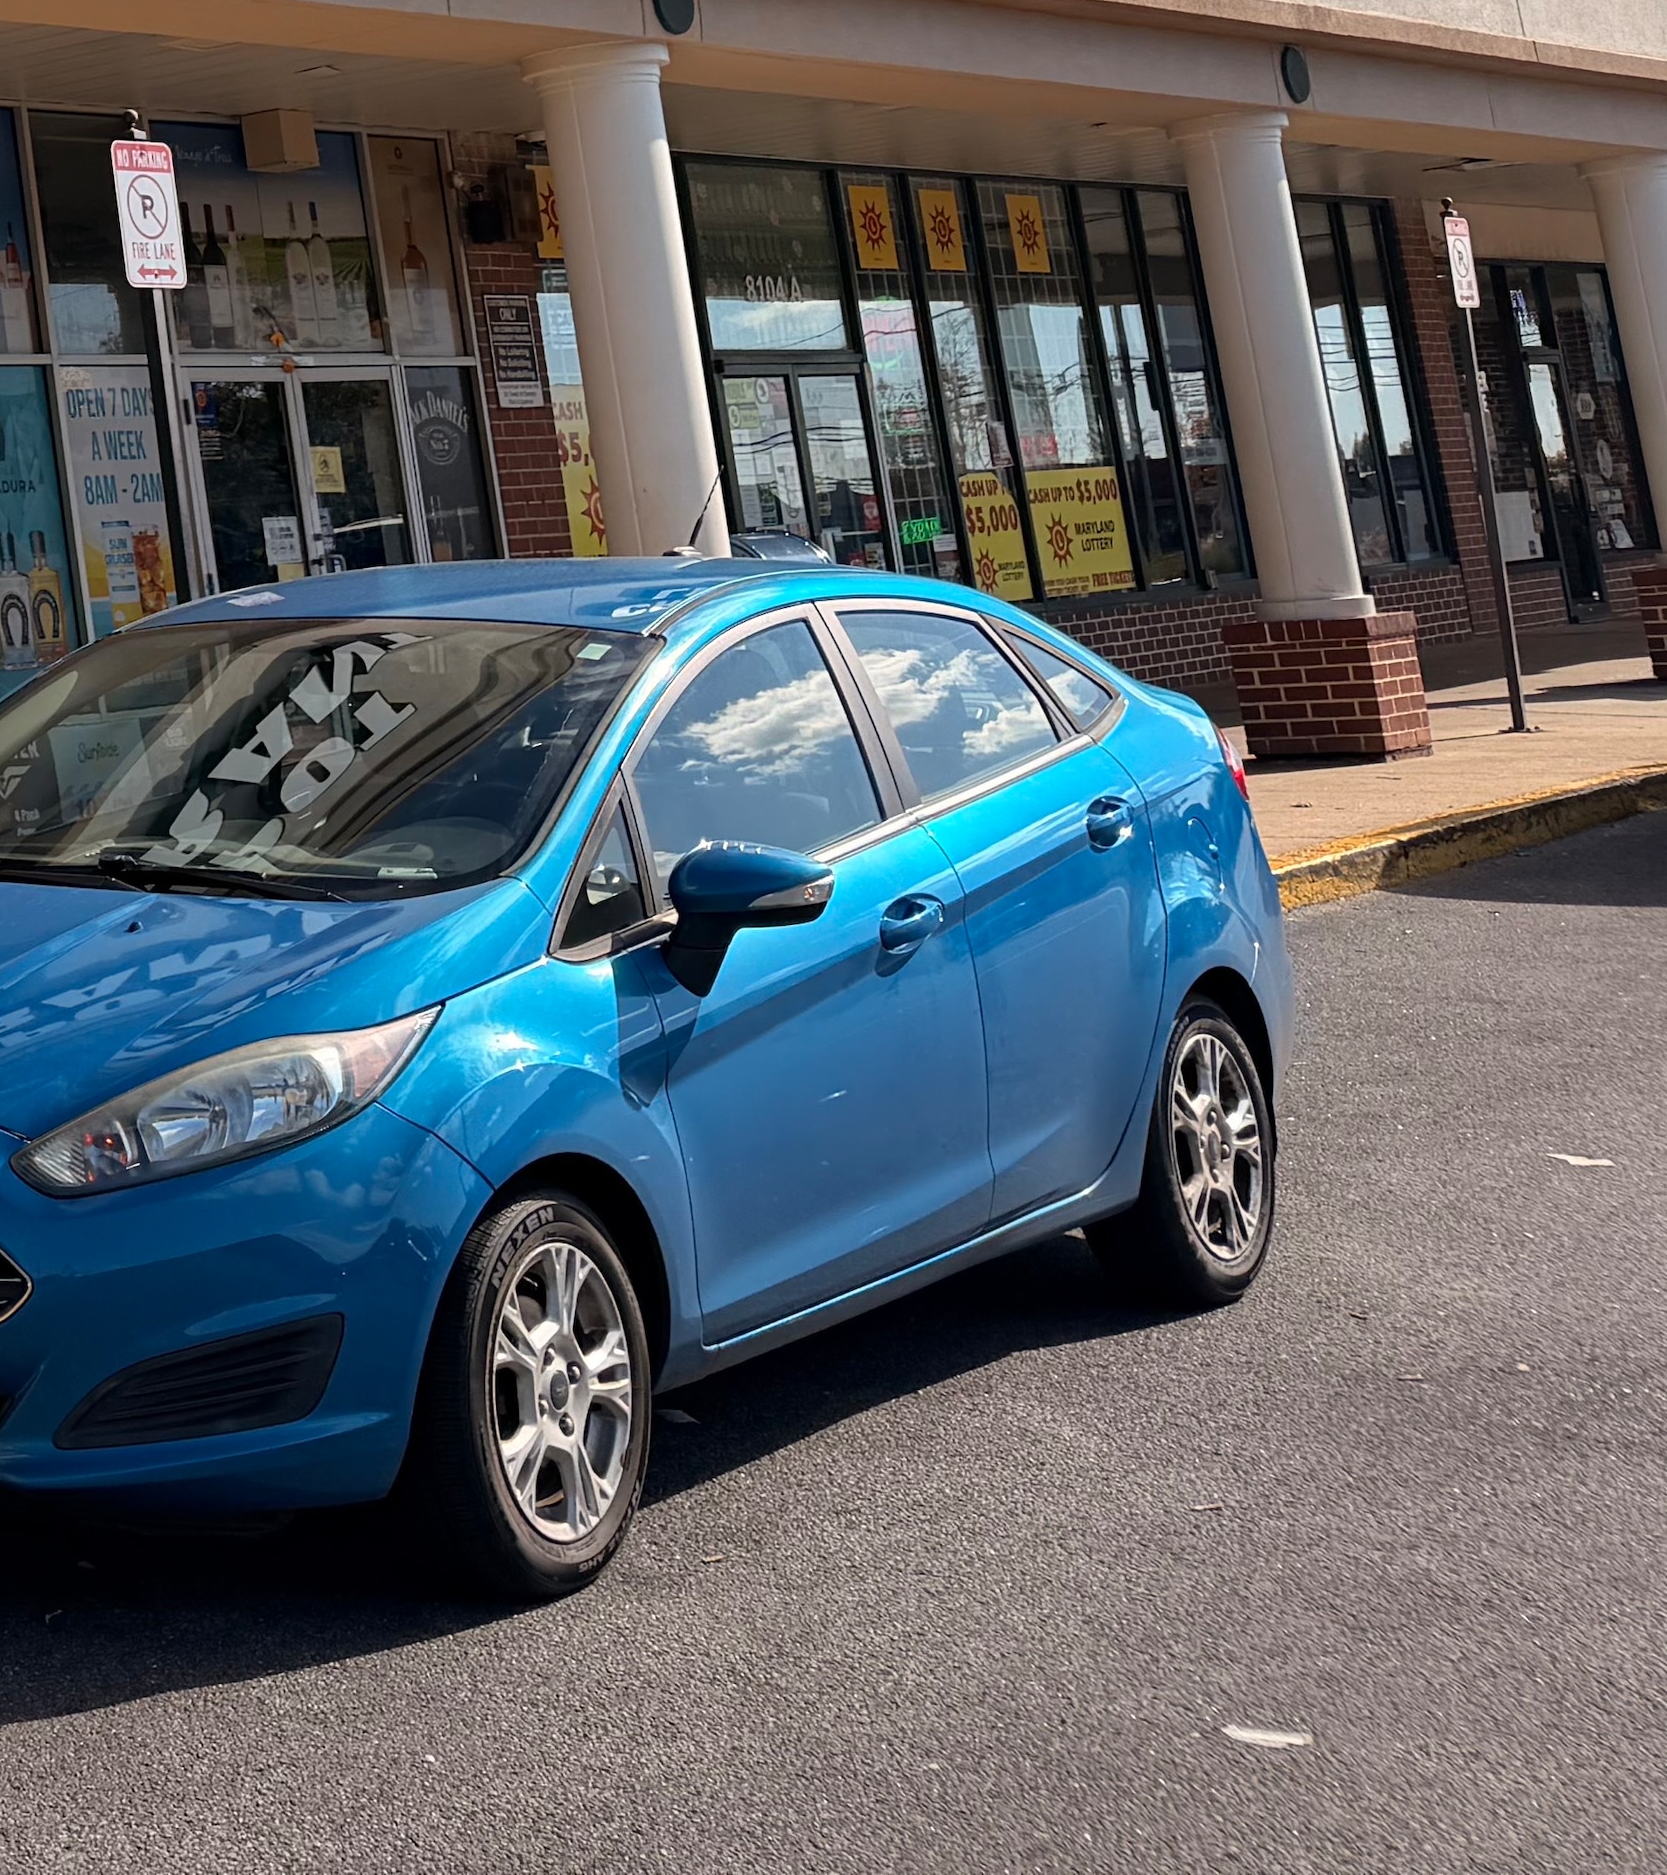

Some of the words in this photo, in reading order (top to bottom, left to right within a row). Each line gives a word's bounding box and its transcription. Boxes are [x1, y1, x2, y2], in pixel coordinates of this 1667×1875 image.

[117, 148, 130, 168] NO
[131, 148, 169, 171] PARKING
[132, 241, 151, 260] FIRE
[153, 241, 177, 261] LANE
[745, 275, 783, 301] 8104
[790, 275, 804, 302] A
[67, 388, 106, 419] OPEN
[107, 387, 116, 417] 7
[553, 401, 584, 422] CASH
[92, 431, 102, 461] A
[104, 430, 147, 461] WEEK
[557, 430, 595, 467] $5,
[84, 475, 118, 506] 8AM
[131, 473, 164, 504] 2AM
[959, 479, 985, 498] CASH
[986, 479, 999, 497] UP
[1029, 487, 1049, 504] CASH
[1051, 486, 1063, 503] UP
[1062, 484, 1075, 502] TO
[1076, 478, 1117, 506] $5,000
[966, 504, 1019, 537] $5,000
[1074, 520, 1115, 536] MARYLAND
[1081, 538, 1114, 552] LOTTERY
[490, 1205, 556, 1291] NEXEN
